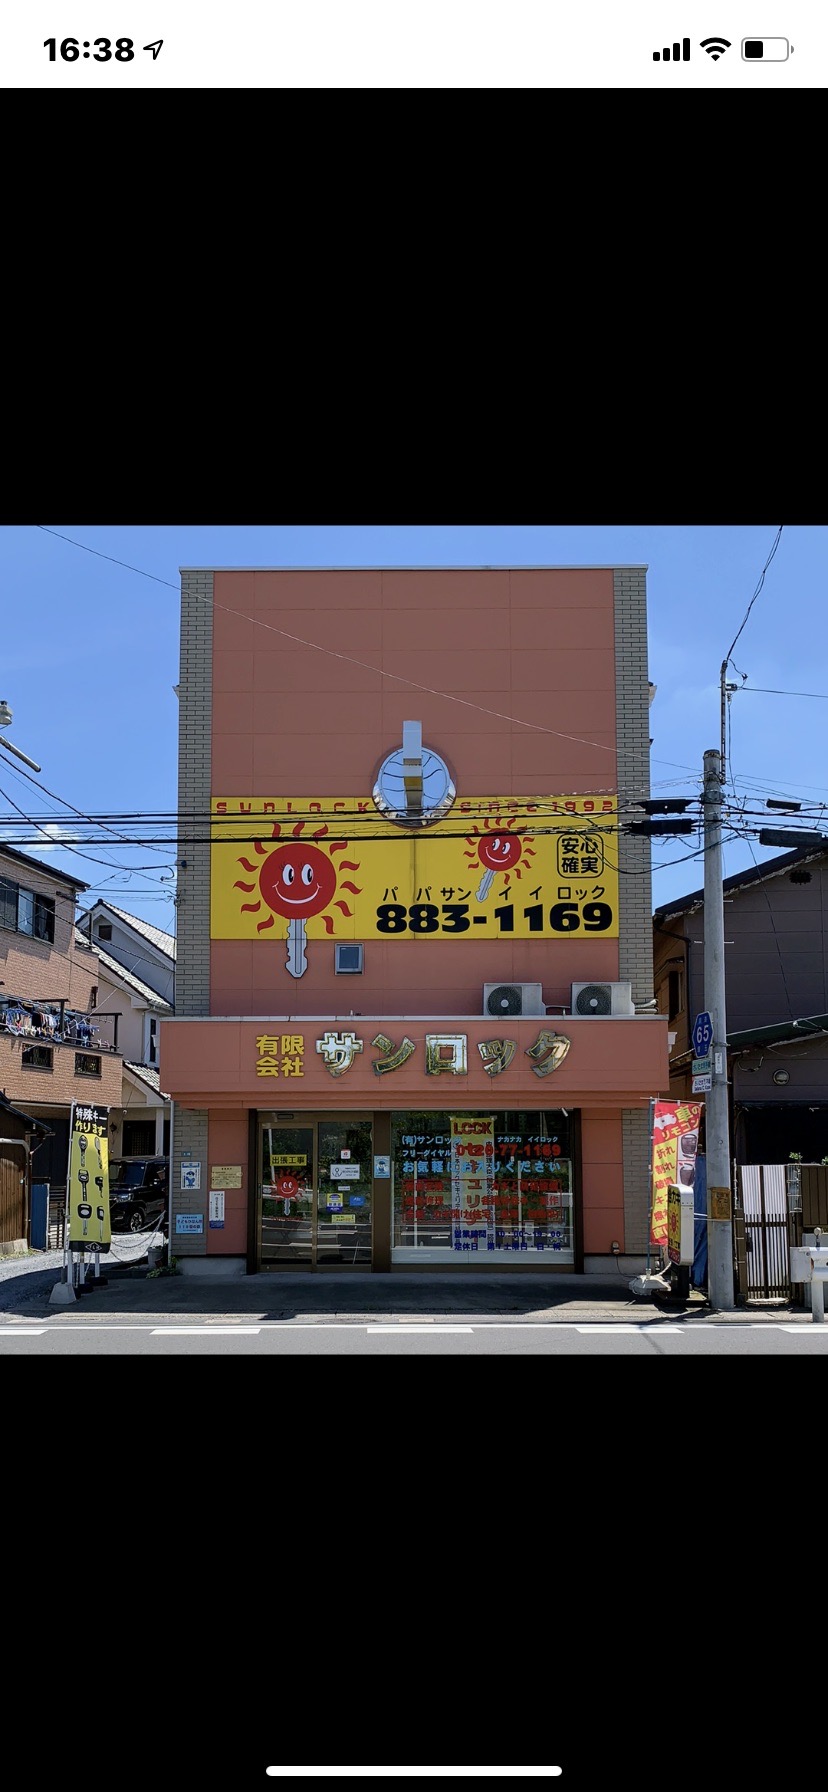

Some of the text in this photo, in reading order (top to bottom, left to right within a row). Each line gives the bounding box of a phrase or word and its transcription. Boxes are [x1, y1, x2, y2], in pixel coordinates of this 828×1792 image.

[552, 800, 613, 812] 1992
[561, 836, 599, 855] 安心
[561, 856, 599, 874] 確実
[440, 886, 472, 901] サン
[557, 885, 606, 901] ロック
[376, 903, 613, 933] 883-1169
[696, 1024, 710, 1044] 65
[255, 1034, 304, 1055] 有限
[315, 1029, 572, 1078] サンロック
[255, 1056, 304, 1077] 会社
[75, 1106, 108, 1121] 特殊キー
[674, 1105, 700, 1123] 車の
[75, 1119, 106, 1136] 作ります
[453, 1121, 492, 1135] LOCK
[661, 1118, 699, 1140] リモコン
[271, 1156, 305, 1164] 出張工事
[656, 1146, 675, 1159] 折れ
